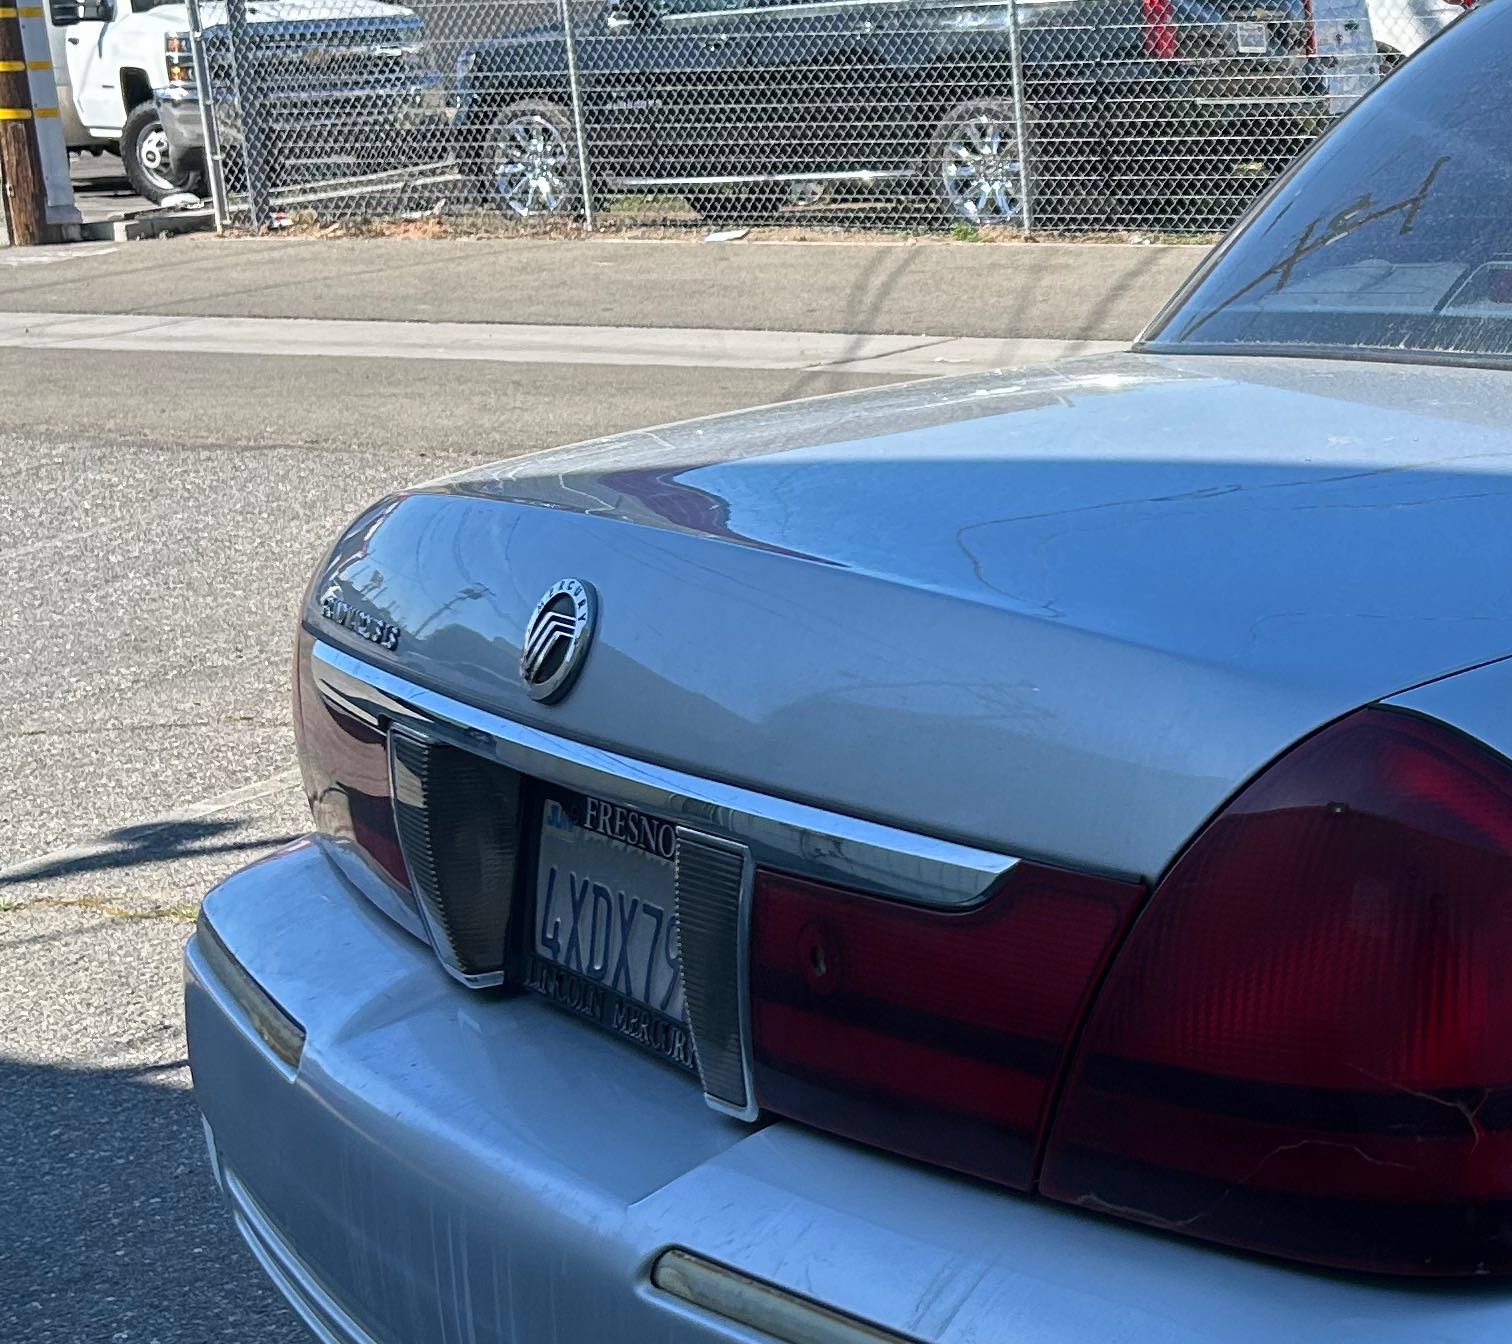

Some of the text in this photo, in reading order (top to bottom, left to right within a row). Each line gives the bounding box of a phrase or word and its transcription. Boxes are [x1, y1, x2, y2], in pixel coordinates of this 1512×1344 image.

[537, 579, 588, 622] MERCURY
[583, 797, 677, 858] FRESNO
[541, 866, 690, 1018] 4XDX79
